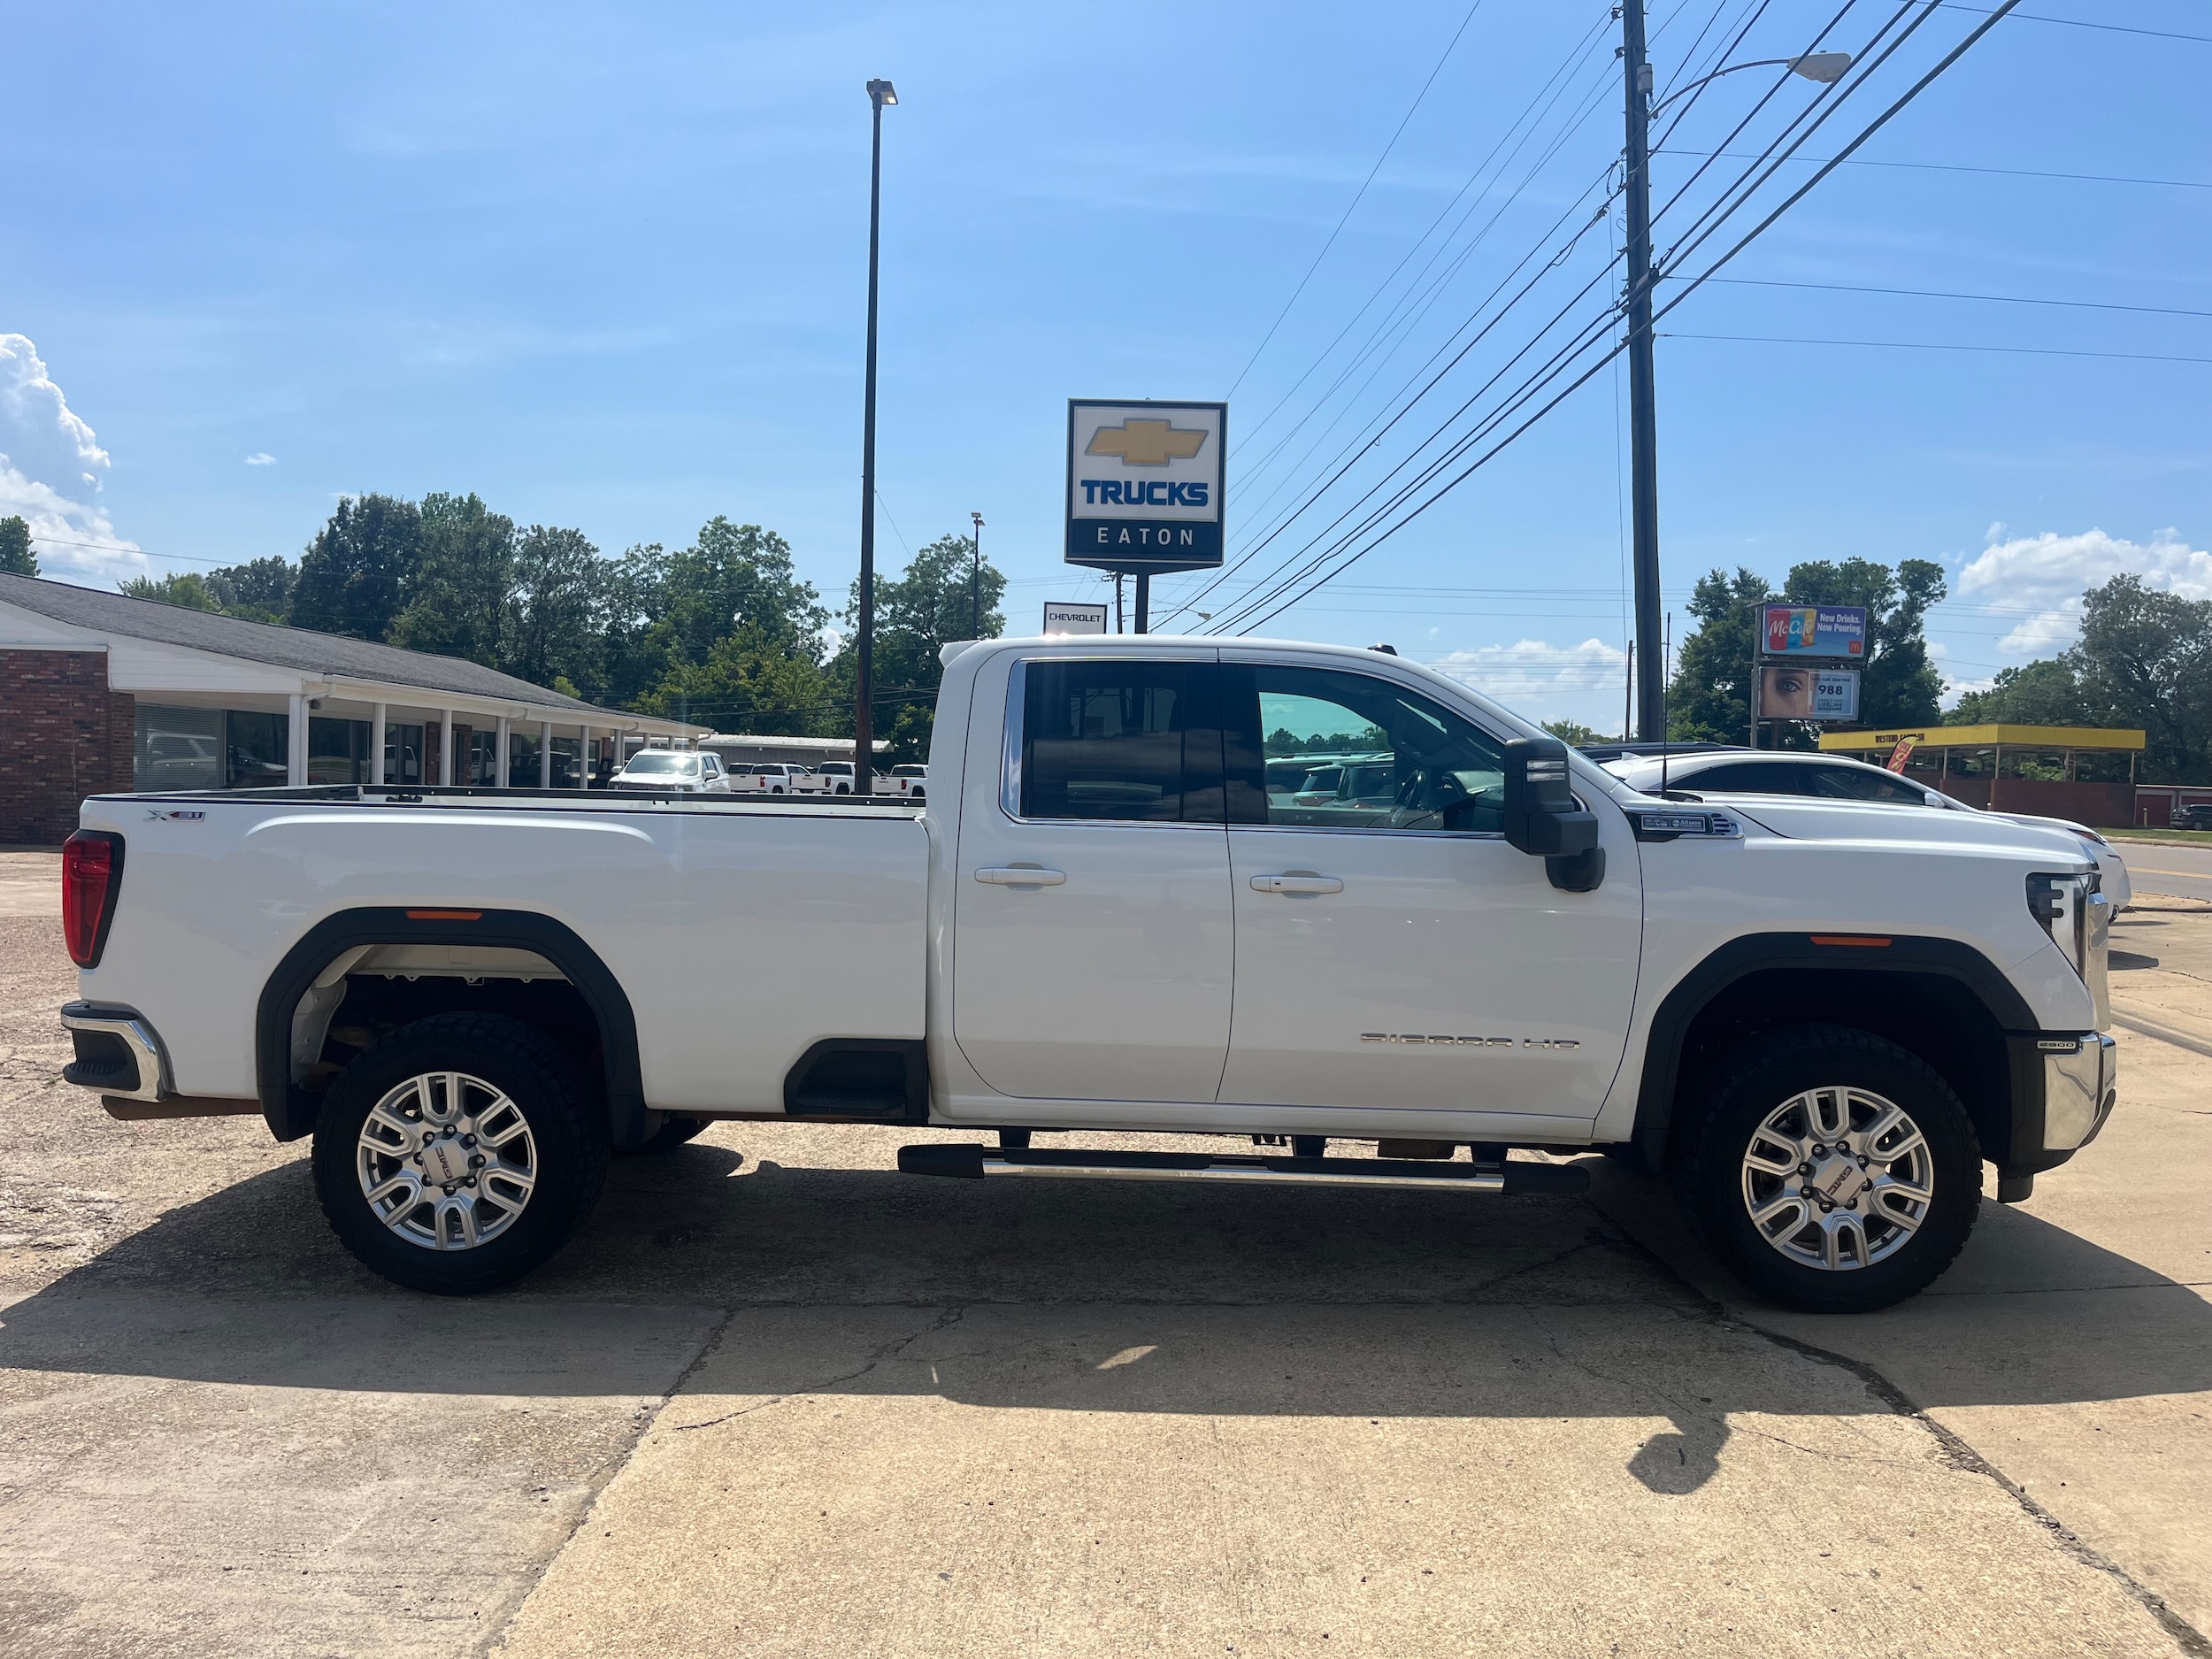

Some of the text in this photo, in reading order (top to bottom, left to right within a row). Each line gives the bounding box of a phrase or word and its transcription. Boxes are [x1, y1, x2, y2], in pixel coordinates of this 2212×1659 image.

[1080, 480, 1209, 507] TRUCKS
[1097, 527, 1193, 546] EATON
[1048, 612, 1102, 623] CHEVROLET
[1819, 613, 1861, 624] New Drinks.
[1769, 619, 1814, 637] McCafé
[1816, 623, 1863, 635] Now Pouring.
[1818, 685, 1843, 695] 988
[1360, 1033, 1580, 1049] SIERRA HD
[434, 1145, 453, 1179] GMC
[1825, 1164, 1854, 1196] GMC
